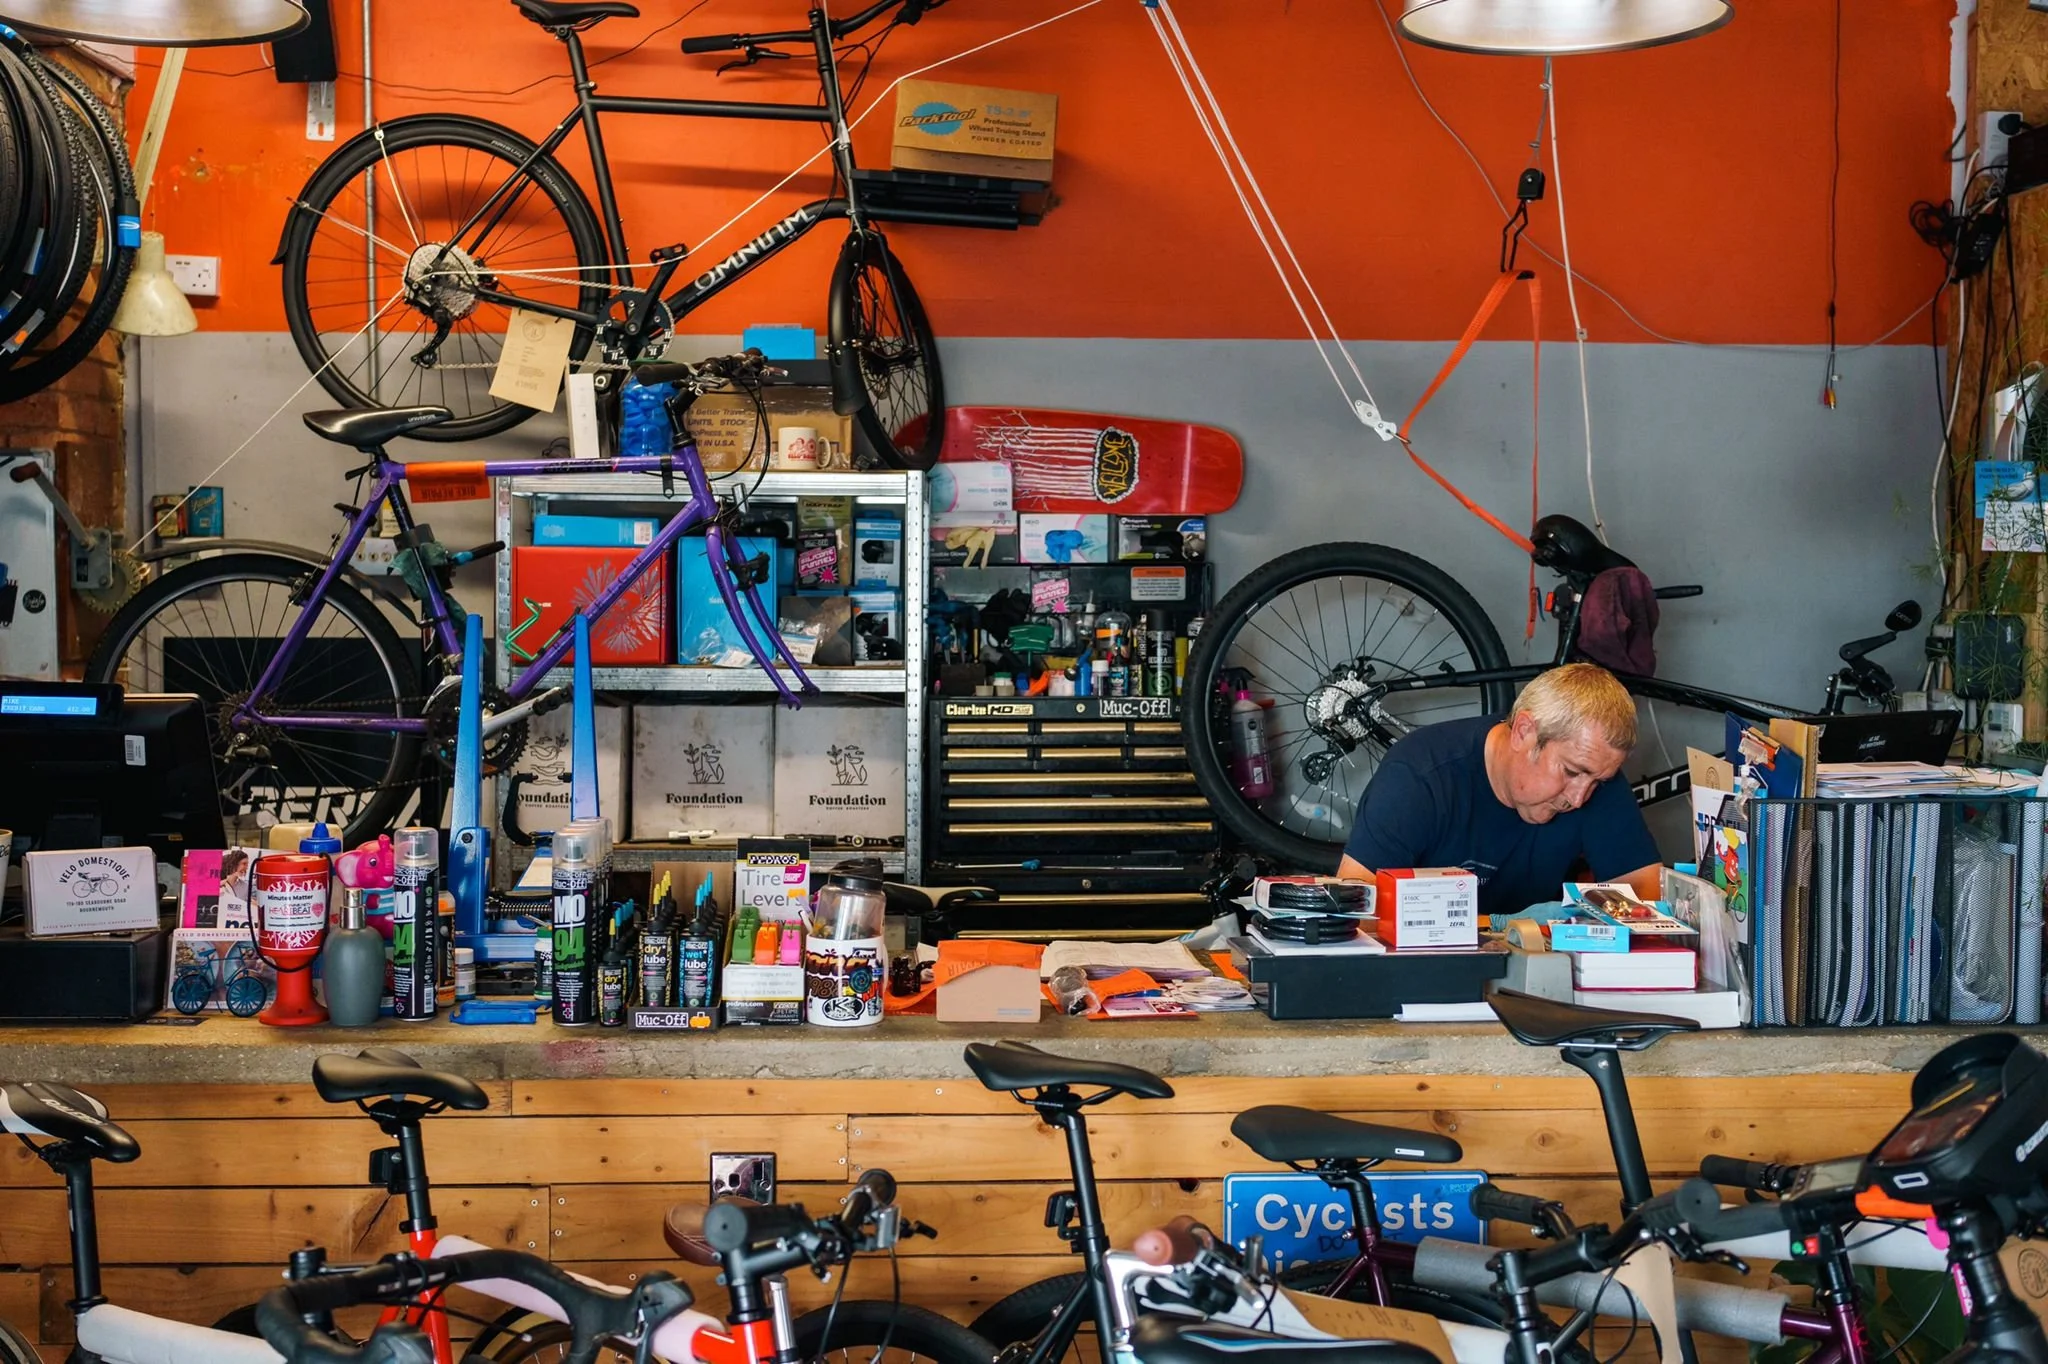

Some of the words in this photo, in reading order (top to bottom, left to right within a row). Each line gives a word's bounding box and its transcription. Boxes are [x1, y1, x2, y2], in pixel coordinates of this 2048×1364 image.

[983, 117, 1032, 128] Professional
[968, 125, 994, 133] Wheel
[996, 127, 1020, 137] Truing
[1022, 129, 1046, 137] Stand
[972, 136, 1007, 144] POWDER
[1010, 139, 1042, 147] COATED
[945, 704, 986, 715] Clarke
[1102, 699, 1168, 715] Muc-Off
[665, 792, 743, 804] Foundation
[808, 794, 887, 806] Foundation
[59, 864, 77, 884] VELO
[78, 856, 131, 880] DOMESTIQUE
[742, 869, 781, 886] Tire
[554, 894, 586, 923] MO
[554, 927, 586, 961] 94
[644, 945, 661, 955] dry
[643, 955, 667, 963] lube
[685, 950, 703, 958] wet
[684, 959, 708, 968] lube
[604, 976, 618, 984] dry
[638, 1012, 687, 1027] Muc-Off
